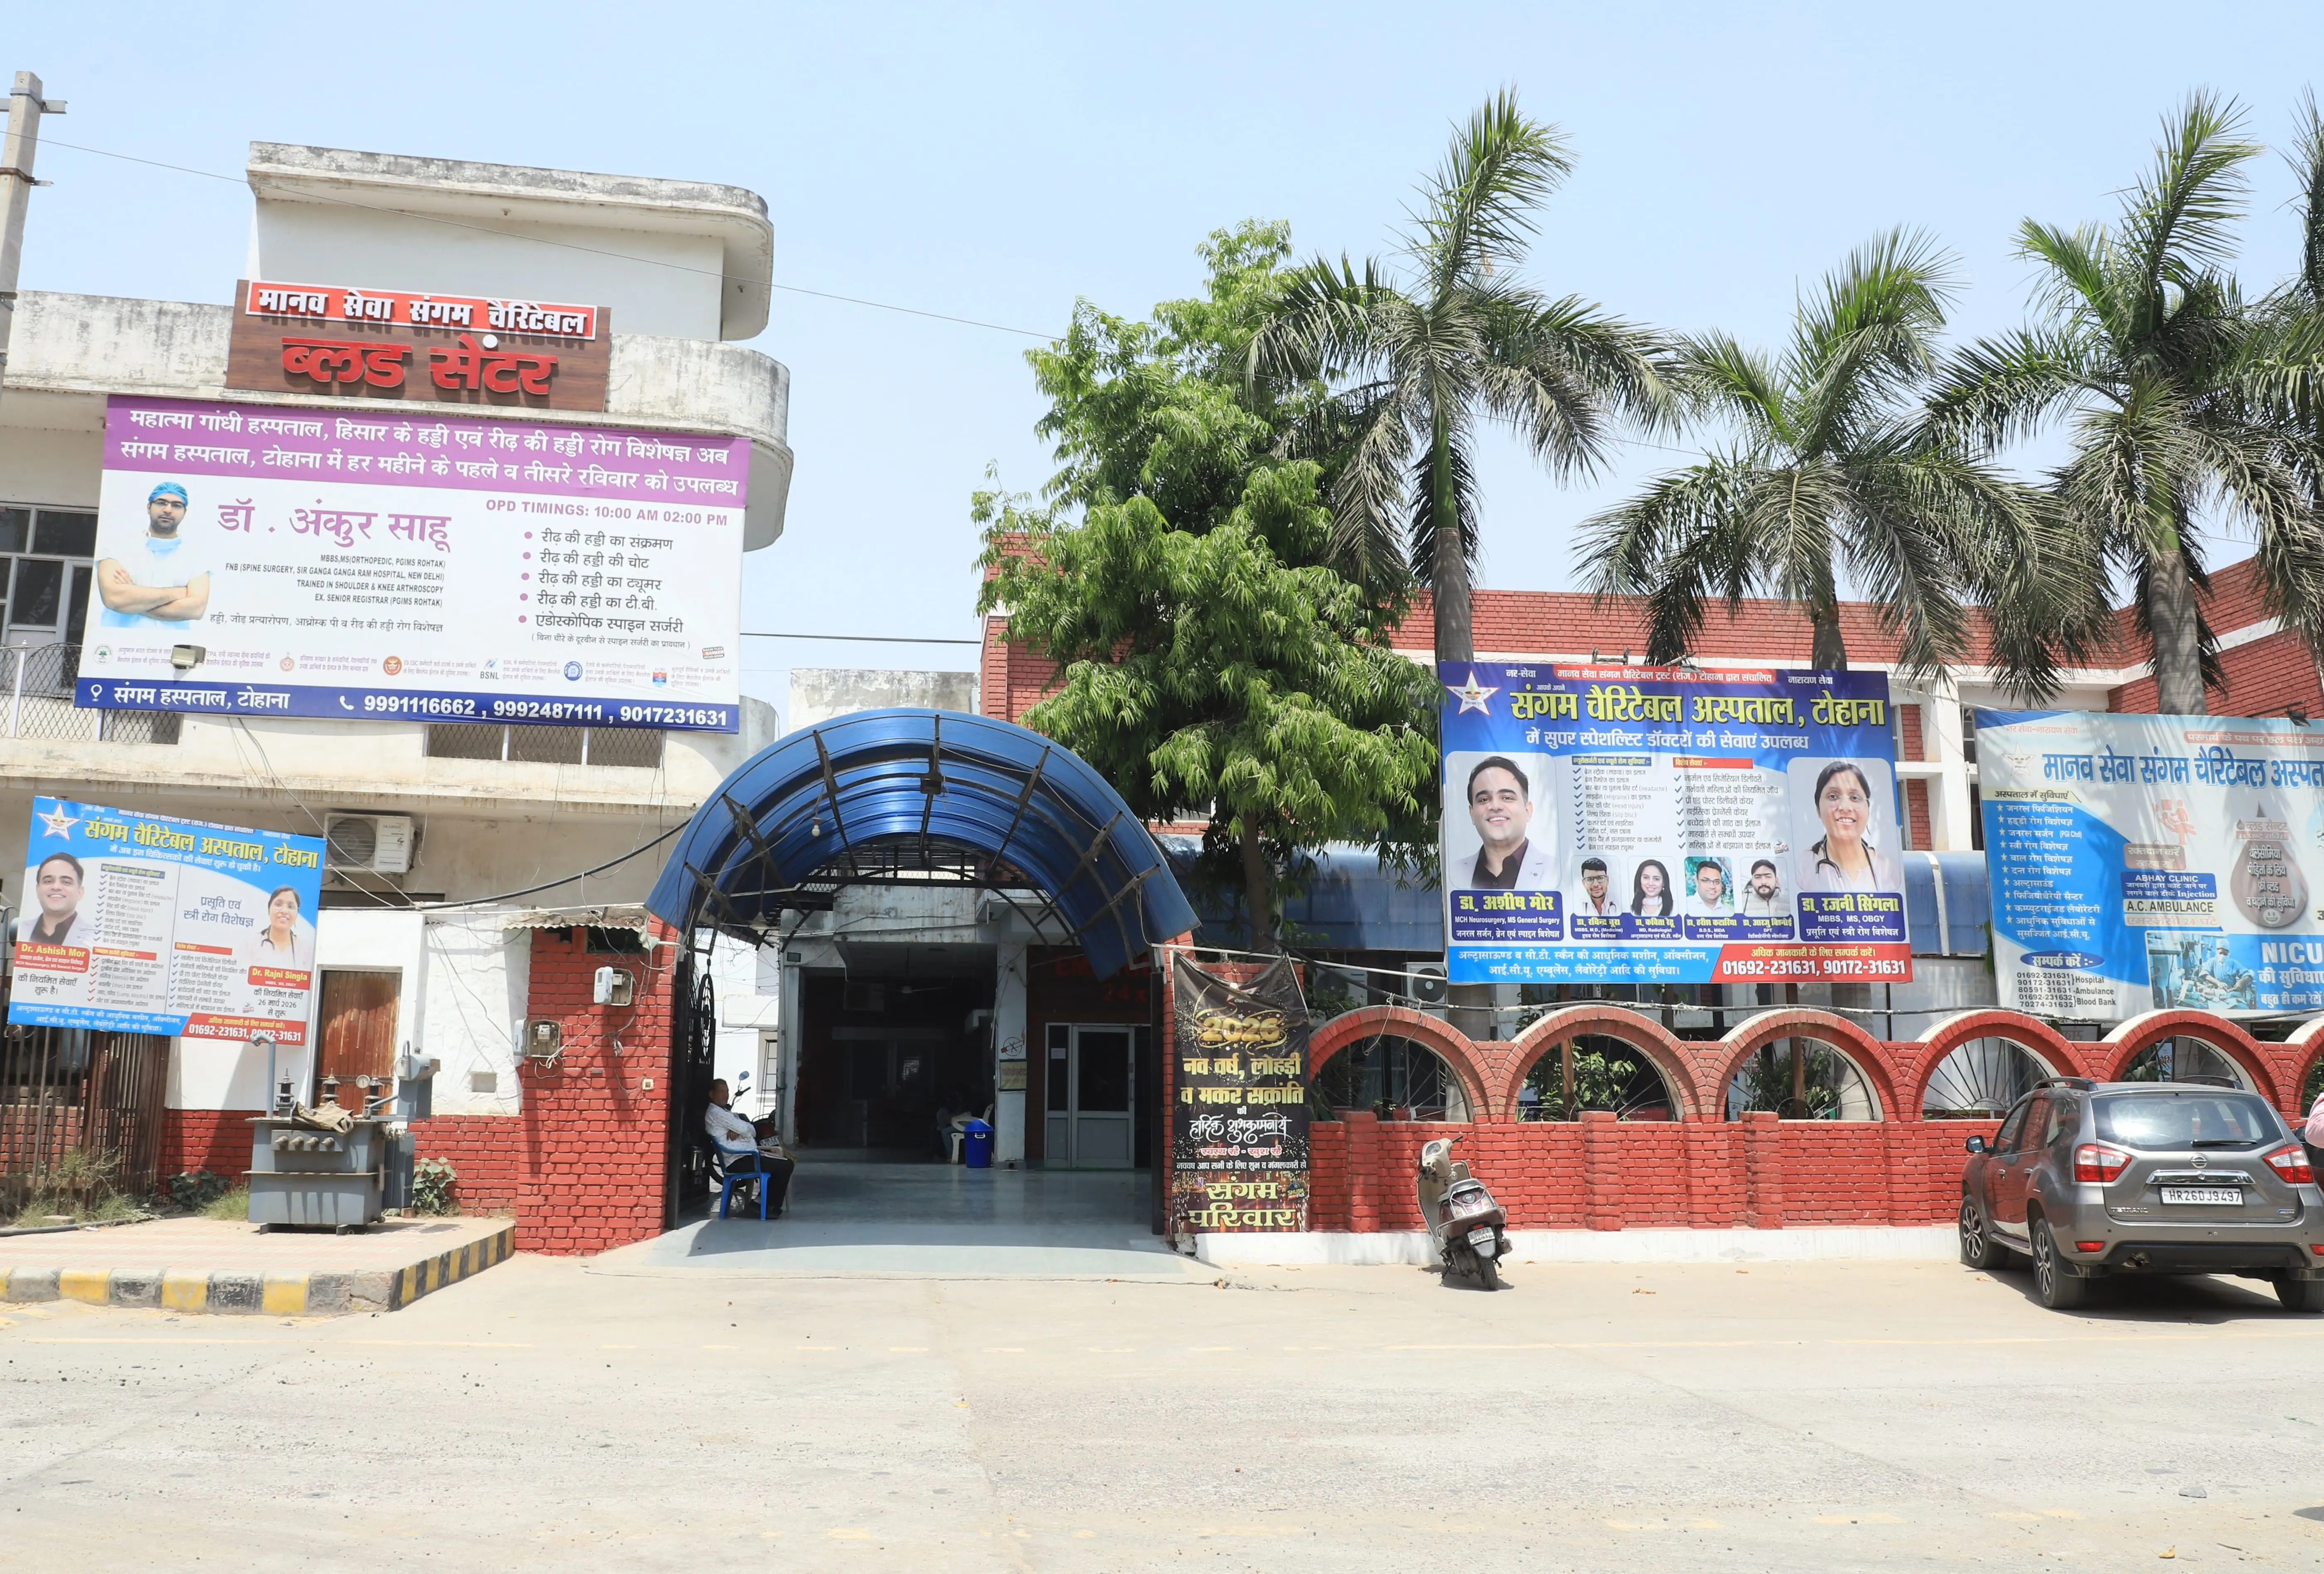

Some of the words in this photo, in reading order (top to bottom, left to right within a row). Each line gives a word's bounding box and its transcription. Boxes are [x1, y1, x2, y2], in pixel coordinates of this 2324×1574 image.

[258, 288, 328, 314] मानव
[343, 290, 394, 320] सेवा
[410, 296, 473, 325] संगम
[488, 298, 587, 333] चैरिटेबल
[282, 337, 412, 388] ब्लड
[429, 334, 558, 395] सेंटर
[130, 410, 193, 430] महात्मा
[200, 410, 243, 432] गांधी
[248, 418, 329, 441] हस्पताल,
[335, 418, 389, 442] हिसार
[394, 422, 412, 443] के
[417, 424, 450, 448] हड्डी
[455, 426, 482, 449] एवं
[488, 428, 519, 453] रीढ़
[524, 430, 548, 451] की
[553, 432, 584, 457] हड्डी
[590, 434, 621, 457] रोग
[627, 438, 692, 462] विशेषज्ञ
[697, 448, 729, 464] अब
[121, 437, 168, 460] संगम
[174, 445, 256, 468] हस्पताल,
[263, 445, 322, 469] टोहाना
[327, 449, 343, 470] में
[348, 454, 373, 472] हर
[378, 453, 426, 474] महीने
[431, 454, 450, 475] के
[456, 459, 498, 480] पहले
[504, 466, 518, 481] व
[524, 462, 572, 484] तीसरे
[578, 464, 640, 488] रविवार
[645, 470, 667, 490] को
[673, 476, 739, 496] उपलब्ध
[486, 499, 516, 512] OPD
[522, 501, 589, 516] TIMINGS:
[594, 506, 631, 519] 10:00
[636, 509, 658, 521] AM
[663, 511, 701, 524] 02:00
[706, 514, 727, 526] PM
[289, 498, 378, 548] अंकुर
[388, 513, 452, 553] साहू
[226, 563, 238, 571] FNB
[240, 563, 261, 572] (SPINE
[263, 564, 295, 574] SURGERY,
[297, 566, 308, 574] SIR
[309, 566, 331, 576] GANGA
[333, 568, 356, 577] GANGA
[357, 569, 372, 577] RAM
[373, 570, 406, 580] HOSPITAL,
[408, 571, 422, 580] NEW
[424, 572, 444, 581] DELHI)
[395, 557, 415, 566] PGIMS
[417, 558, 446, 569] ROHTAK)
[297, 580, 324, 588] TRAINED
[335, 581, 369, 591] SHOULDER
[377, 583, 395, 591] KNEE
[396, 584, 443, 593] ARTHROSCOPY
[327, 594, 351, 603] SENIOR
[353, 595, 388, 604] REGISTRAR
[390, 597, 413, 606] (PGIMS
[414, 598, 443, 608] ROHTAK)
[536, 611, 603, 629] एंडोस्कोपिक
[607, 620, 646, 632] स्पाइन
[650, 617, 684, 633] सर्जरी
[480, 671, 499, 680] BSNL
[114, 683, 155, 704] संगम
[161, 690, 231, 710] हस्पताल,
[238, 688, 290, 710] टोहाना
[1510, 684, 1578, 720] संगम
[1585, 685, 1682, 722] चैरिटेबल
[1691, 696, 1805, 728] अस्पताल,
[1810, 690, 1885, 726] टोहाना
[364, 695, 475, 715] 9991116662
[494, 700, 602, 720] 9992487111
[621, 708, 726, 726] 9017231631
[1525, 727, 1541, 745] में
[1544, 731, 1576, 749] सुपर
[1648, 730, 1692, 748] डॉक्टरों
[1696, 730, 1716, 748] की
[1720, 732, 1757, 749] सेवाएं
[1761, 735, 1809, 749] उपलब्ध
[2042, 754, 2095, 782] मानव
[2099, 744, 2136, 783] सेवा
[2139, 746, 2190, 783] संगम
[2194, 746, 2266, 788] चैरिटेबल
[85, 816, 130, 842] संगम
[134, 822, 195, 852] चैरिटेबल
[200, 837, 269, 864] अस्पताल,
[273, 842, 319, 869] टोहाना
[201, 896, 225, 909] प्रसूति
[229, 900, 241, 910] एवं
[1459, 895, 1479, 913] डा.
[1483, 893, 1526, 910] अशीष
[1529, 893, 1554, 910] मोर
[1801, 897, 1820, 914] डा.
[1823, 896, 1854, 912] रजनी
[1857, 894, 1900, 912] सिंगला
[2127, 901, 2147, 912] A.C.
[2150, 901, 2214, 912] AMBULANCE
[183, 909, 199, 925] स्त्री
[202, 910, 219, 925] रोग
[222, 911, 253, 927] विशेषज्ञ
[1469, 916, 1507, 925] Neurosurgery,
[1539, 917, 1560, 925] Surgery
[1818, 915, 1843, 924] MBBS,
[1846, 915, 1861, 924] MS,
[22, 944, 33, 952] Dr.
[36, 945, 66, 956] Ashish
[69, 948, 86, 957] Mor
[2261, 942, 2323, 964] NICU
[264, 969, 283, 980] Rajni
[285, 971, 307, 981] Singla
[1722, 960, 1820, 977] 01692-231631,
[1823, 960, 1906, 974] 90172-31631
[2076, 976, 2104, 984] Hospital
[189, 1024, 248, 1039] 01692-231631,
[1203, 1018, 1281, 1042] 2026
[1182, 1058, 1209, 1075] नव
[1213, 1053, 1245, 1080] वर्ष,
[1250, 1052, 1301, 1079] लोहड़ी
[1180, 1087, 1193, 1104] व
[1198, 1087, 1243, 1104] मकर
[1246, 1081, 1304, 1105] सक्रांति
[1189, 1114, 1224, 1143] हार्दिक
[1228, 1145, 1240, 1155] रहें
[1247, 1147, 1269, 1157] खुश
[1271, 1145, 1282, 1155] रहें
[1206, 1176, 1279, 1200] संगम
[1188, 1202, 1296, 1227] परिवार
